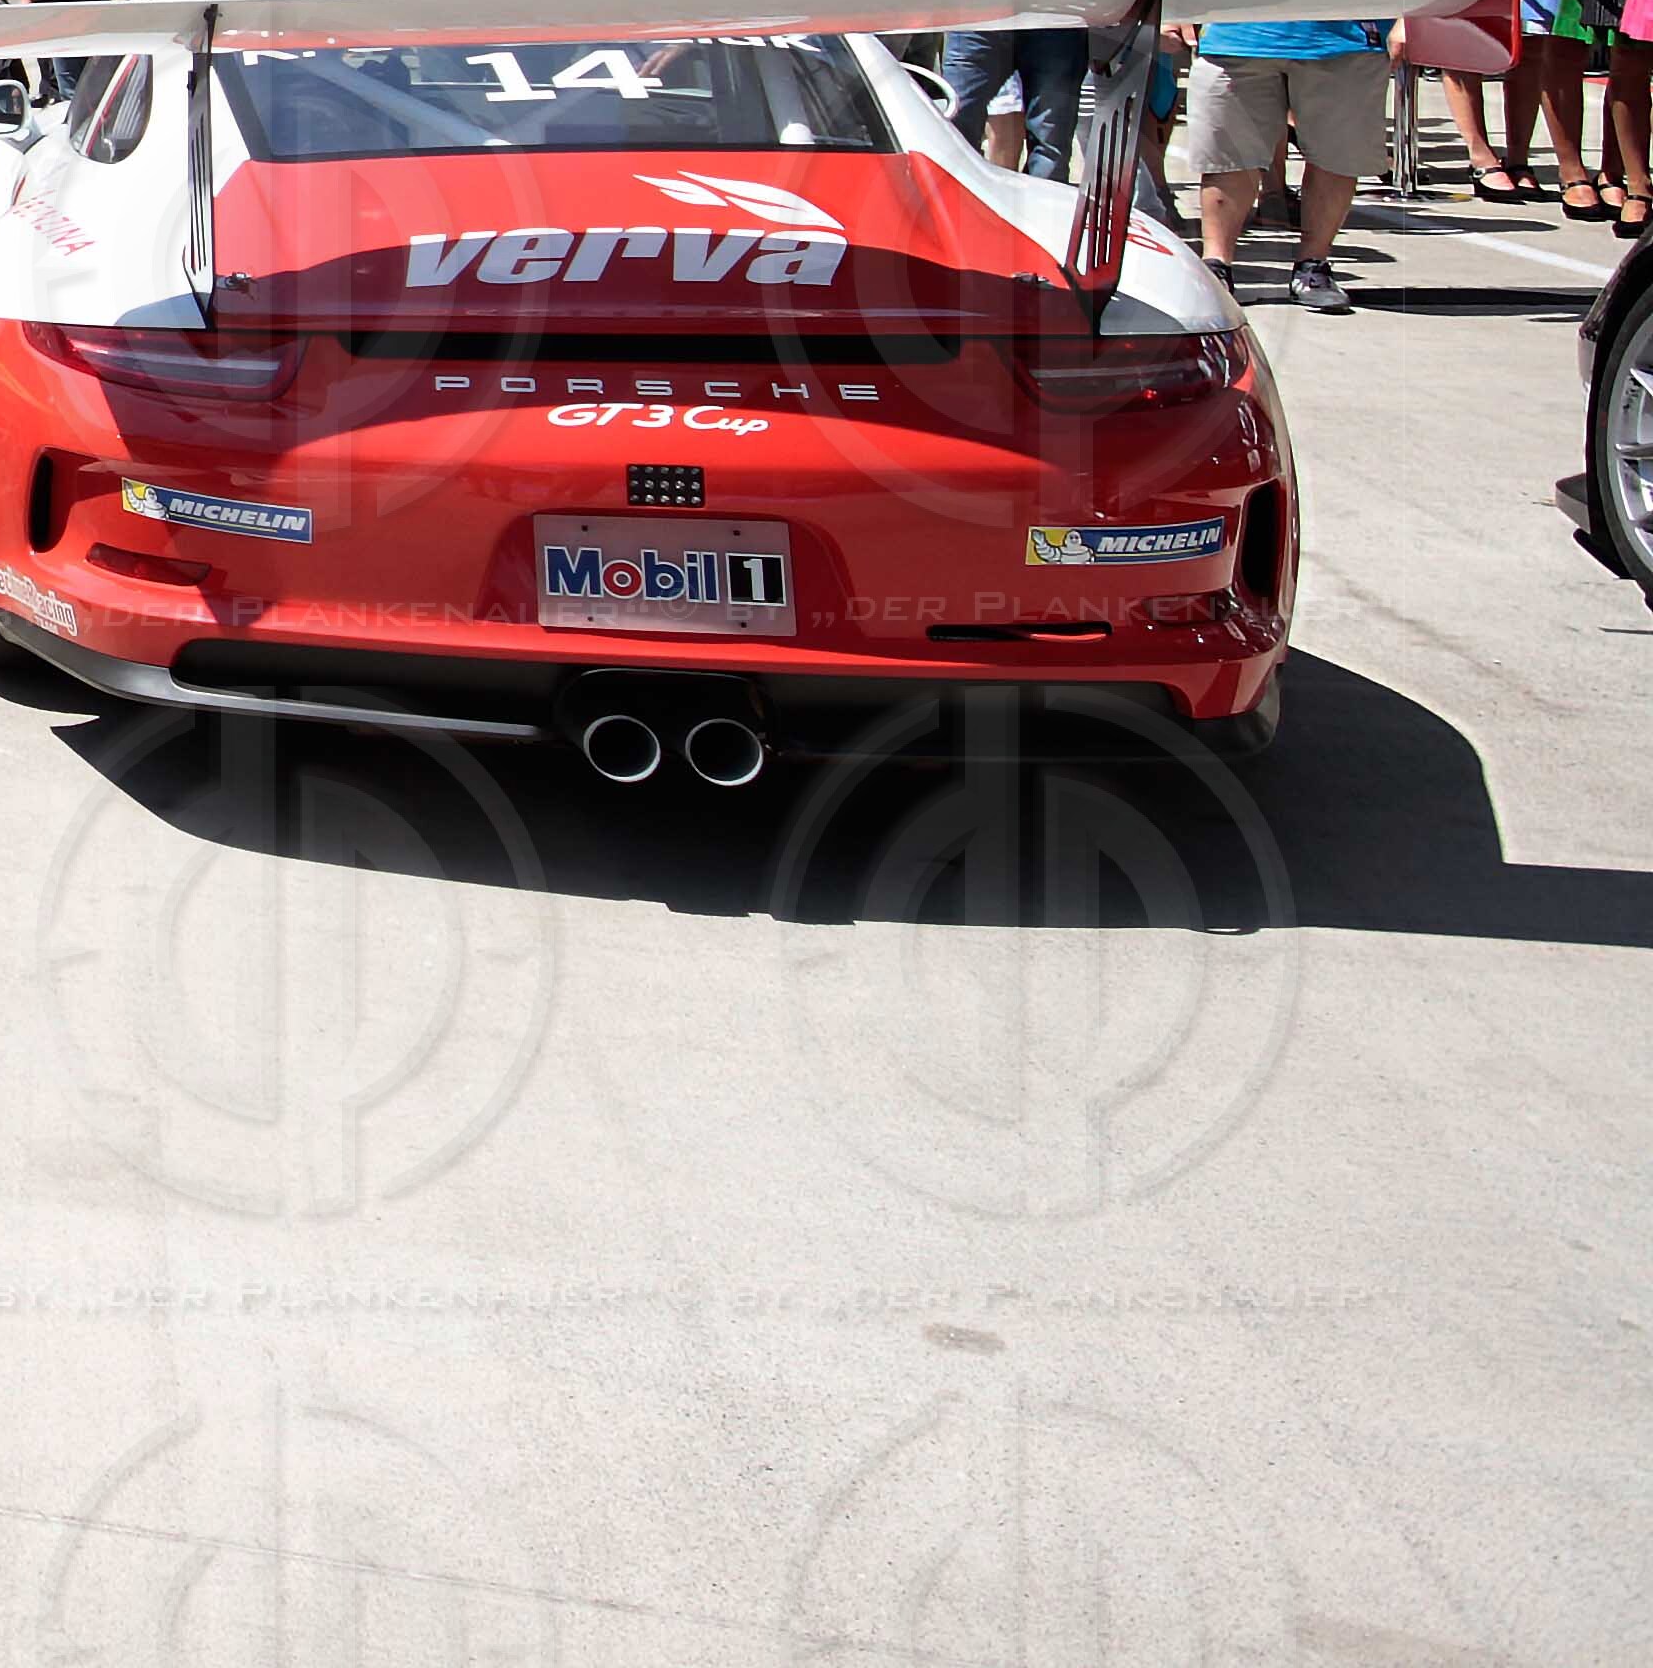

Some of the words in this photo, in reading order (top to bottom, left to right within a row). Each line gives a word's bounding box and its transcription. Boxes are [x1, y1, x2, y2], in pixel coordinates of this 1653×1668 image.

[466, 48, 664, 102] 14
[405, 227, 848, 288] verva
[434, 375, 880, 401] PORSCHE
[683, 405, 770, 436] Cup
[169, 498, 307, 532] MICHELIN
[1096, 524, 1221, 555] MICHELIN
[543, 545, 721, 604] Mobil
